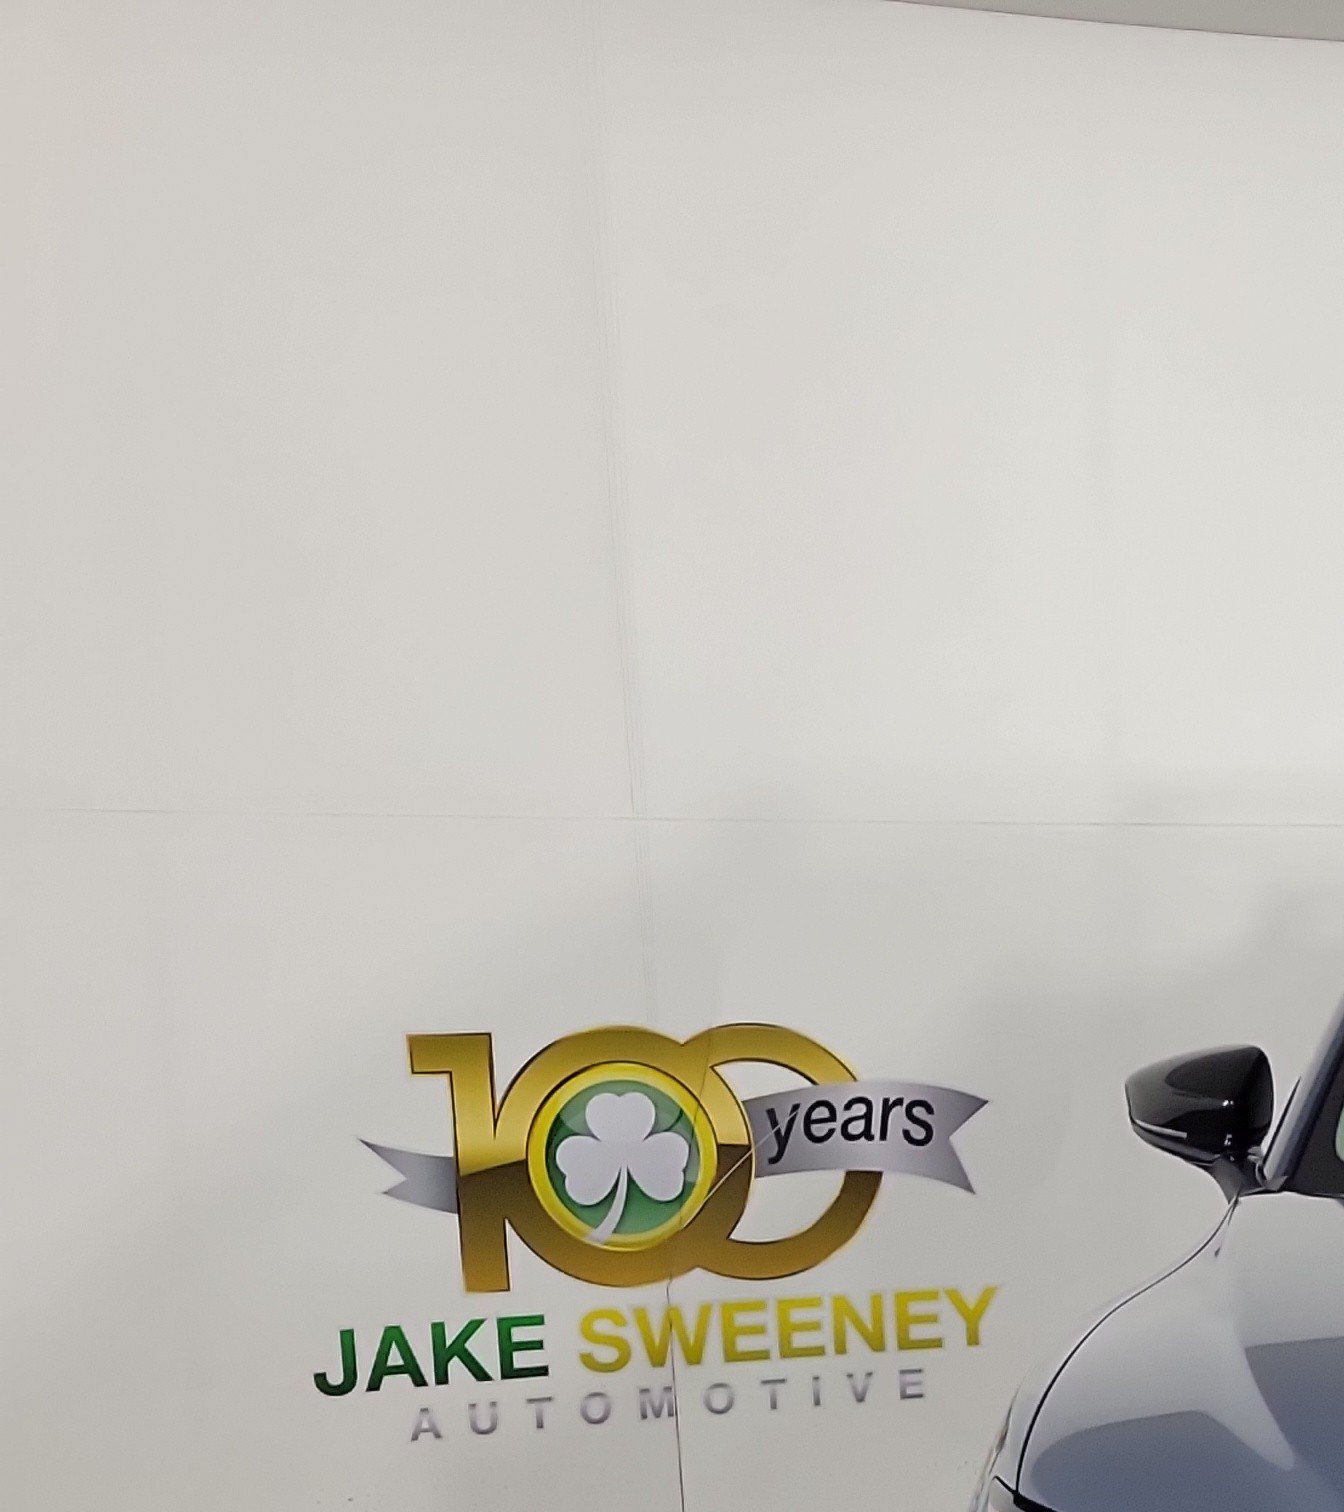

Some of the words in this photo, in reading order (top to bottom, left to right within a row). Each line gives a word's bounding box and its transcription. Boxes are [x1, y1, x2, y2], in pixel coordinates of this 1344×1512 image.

[407, 1023, 883, 1292] 100
[766, 1095, 936, 1164] years
[313, 1314, 549, 1396] JAKE
[578, 1286, 999, 1372] SWEENEY
[410, 1368, 926, 1442] AUTOMOTIVE
